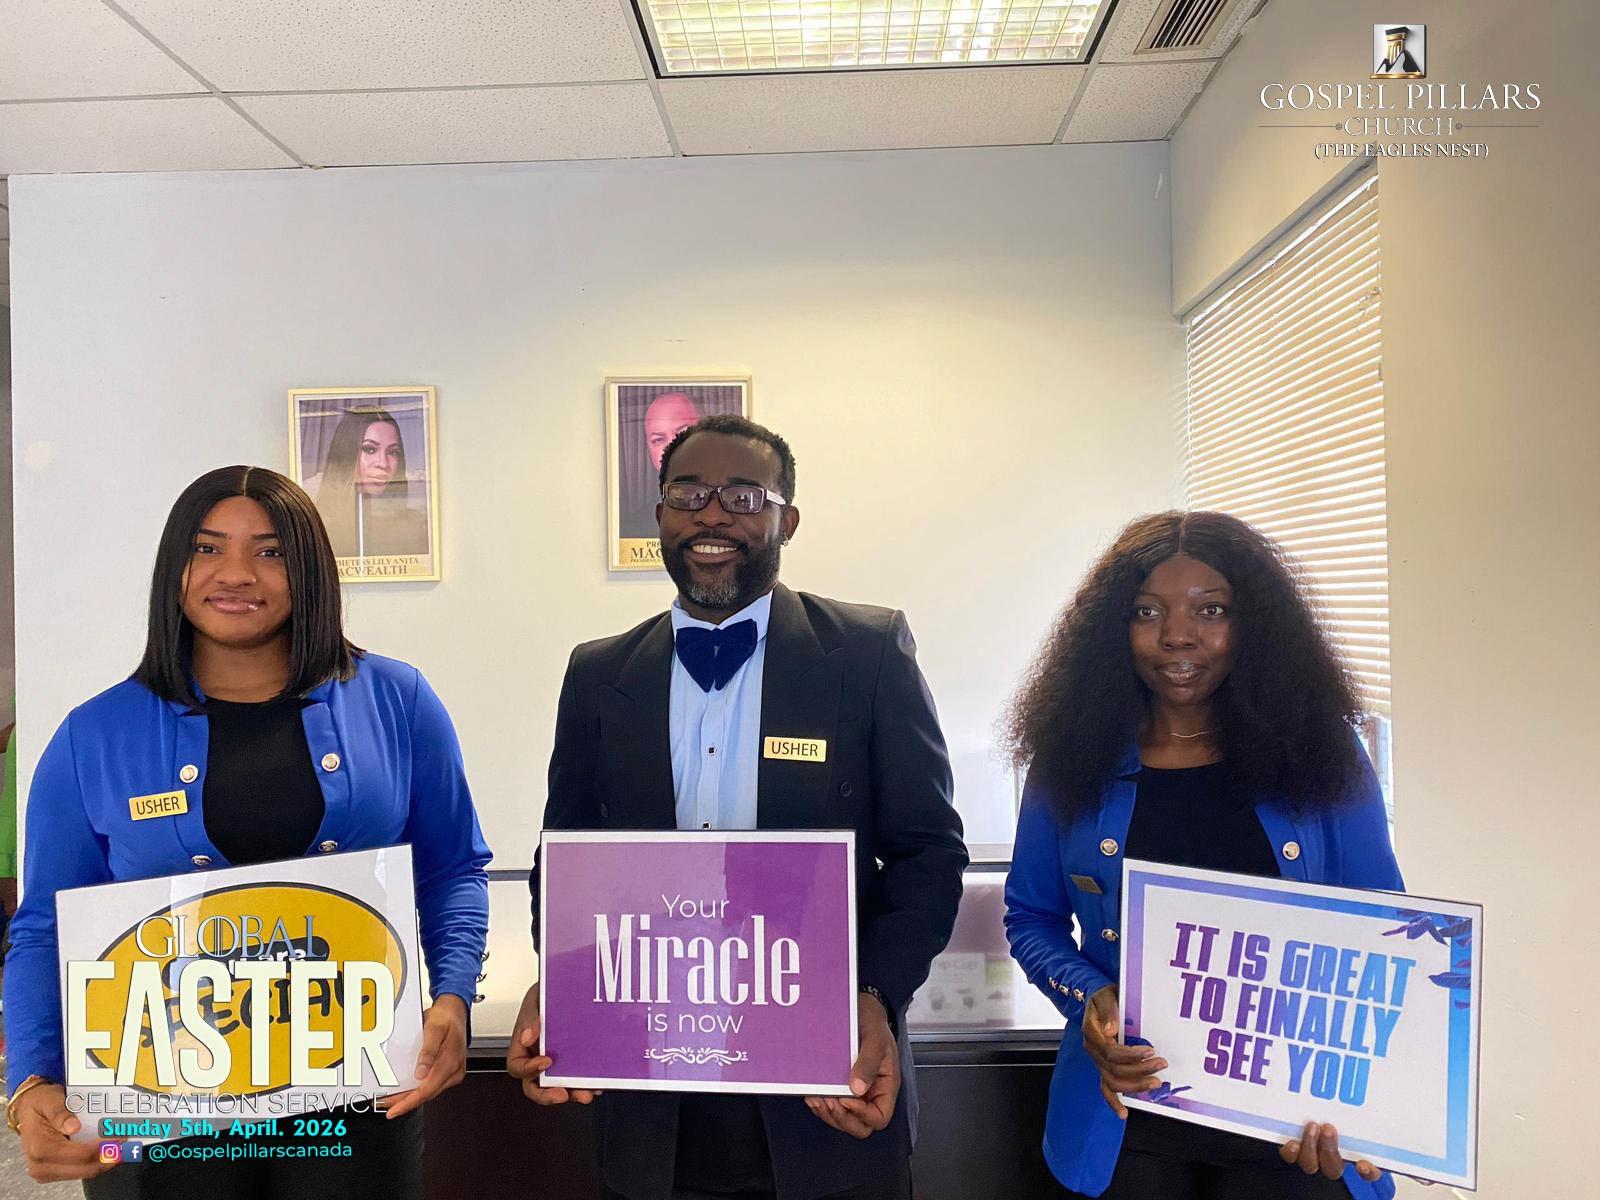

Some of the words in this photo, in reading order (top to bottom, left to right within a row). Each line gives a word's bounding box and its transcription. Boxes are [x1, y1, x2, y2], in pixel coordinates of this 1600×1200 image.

[338, 565, 407, 576] ACWEALTH
[771, 741, 818, 756] USHER
[136, 796, 181, 815] USHER
[661, 894, 730, 918] Your
[593, 914, 800, 1006] Miracle
[1169, 922, 1221, 972] IT
[1227, 930, 1271, 982] IS
[1279, 939, 1417, 1008] GREAT
[647, 1006, 668, 1032] is
[678, 1013, 744, 1033] now
[1179, 972, 1228, 1025] TO
[1235, 983, 1402, 1058] FINALLY
[1203, 1028, 1274, 1086] SEE
[1287, 1043, 1371, 1107] YOU
